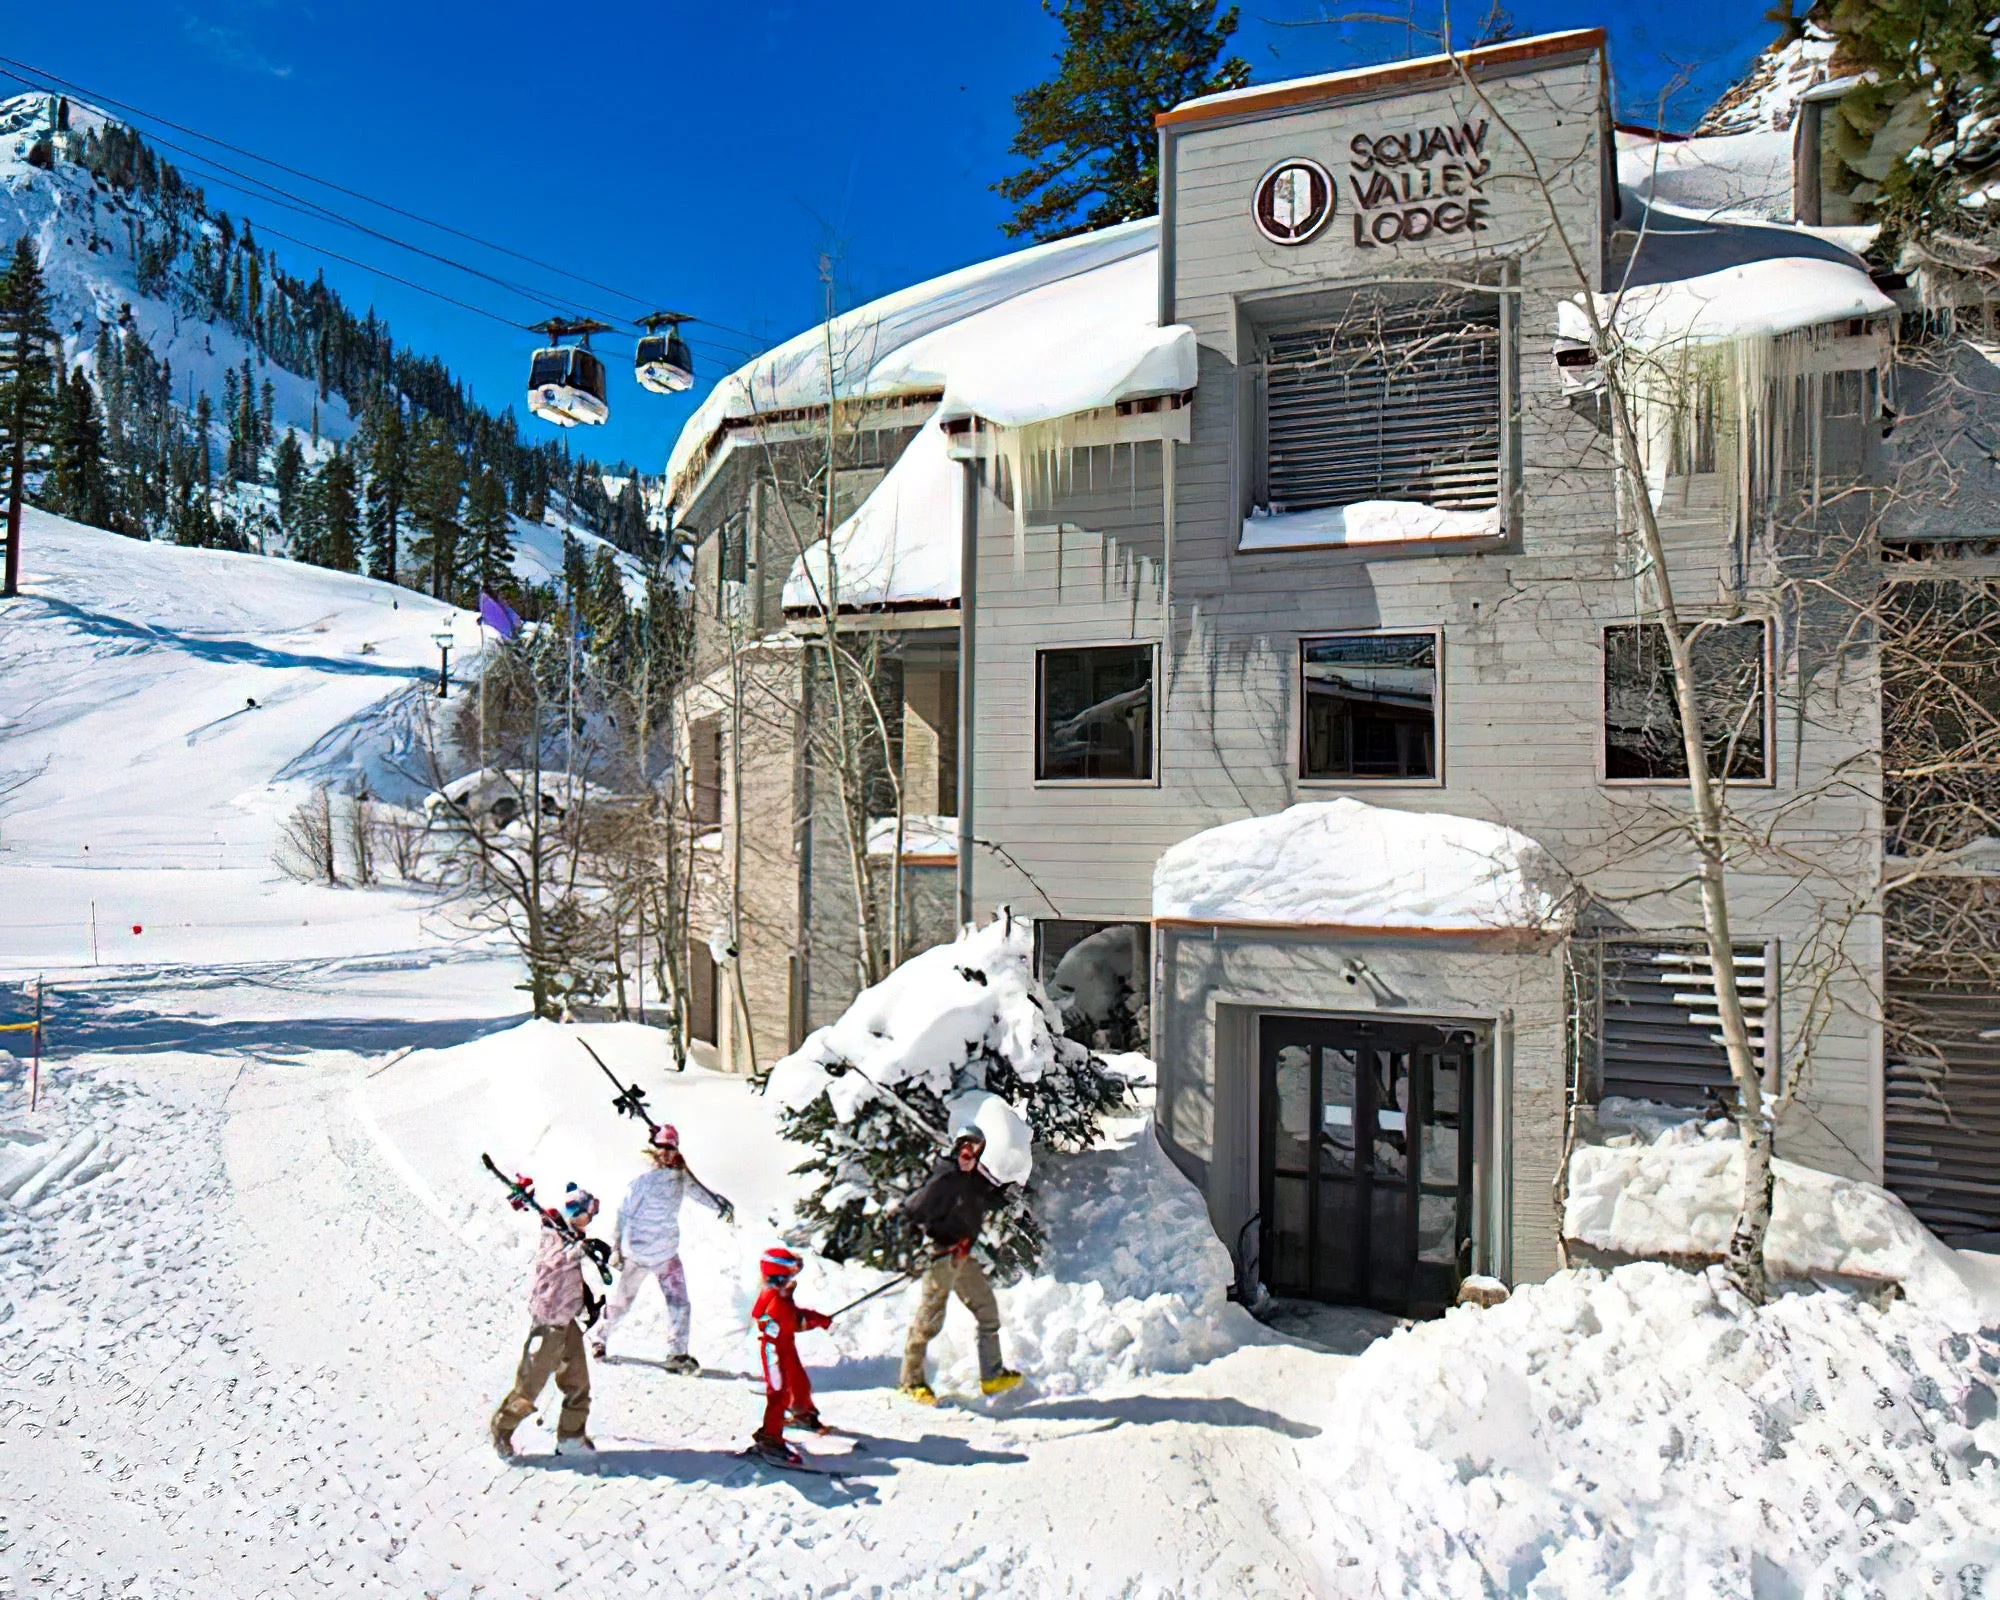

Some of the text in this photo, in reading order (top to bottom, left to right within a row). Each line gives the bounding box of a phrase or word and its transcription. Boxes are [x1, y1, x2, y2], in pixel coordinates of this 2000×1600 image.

[1350, 119, 1489, 171] SQUAW
[1349, 159, 1491, 210] VALLEY
[1353, 198, 1490, 248] LODGE
